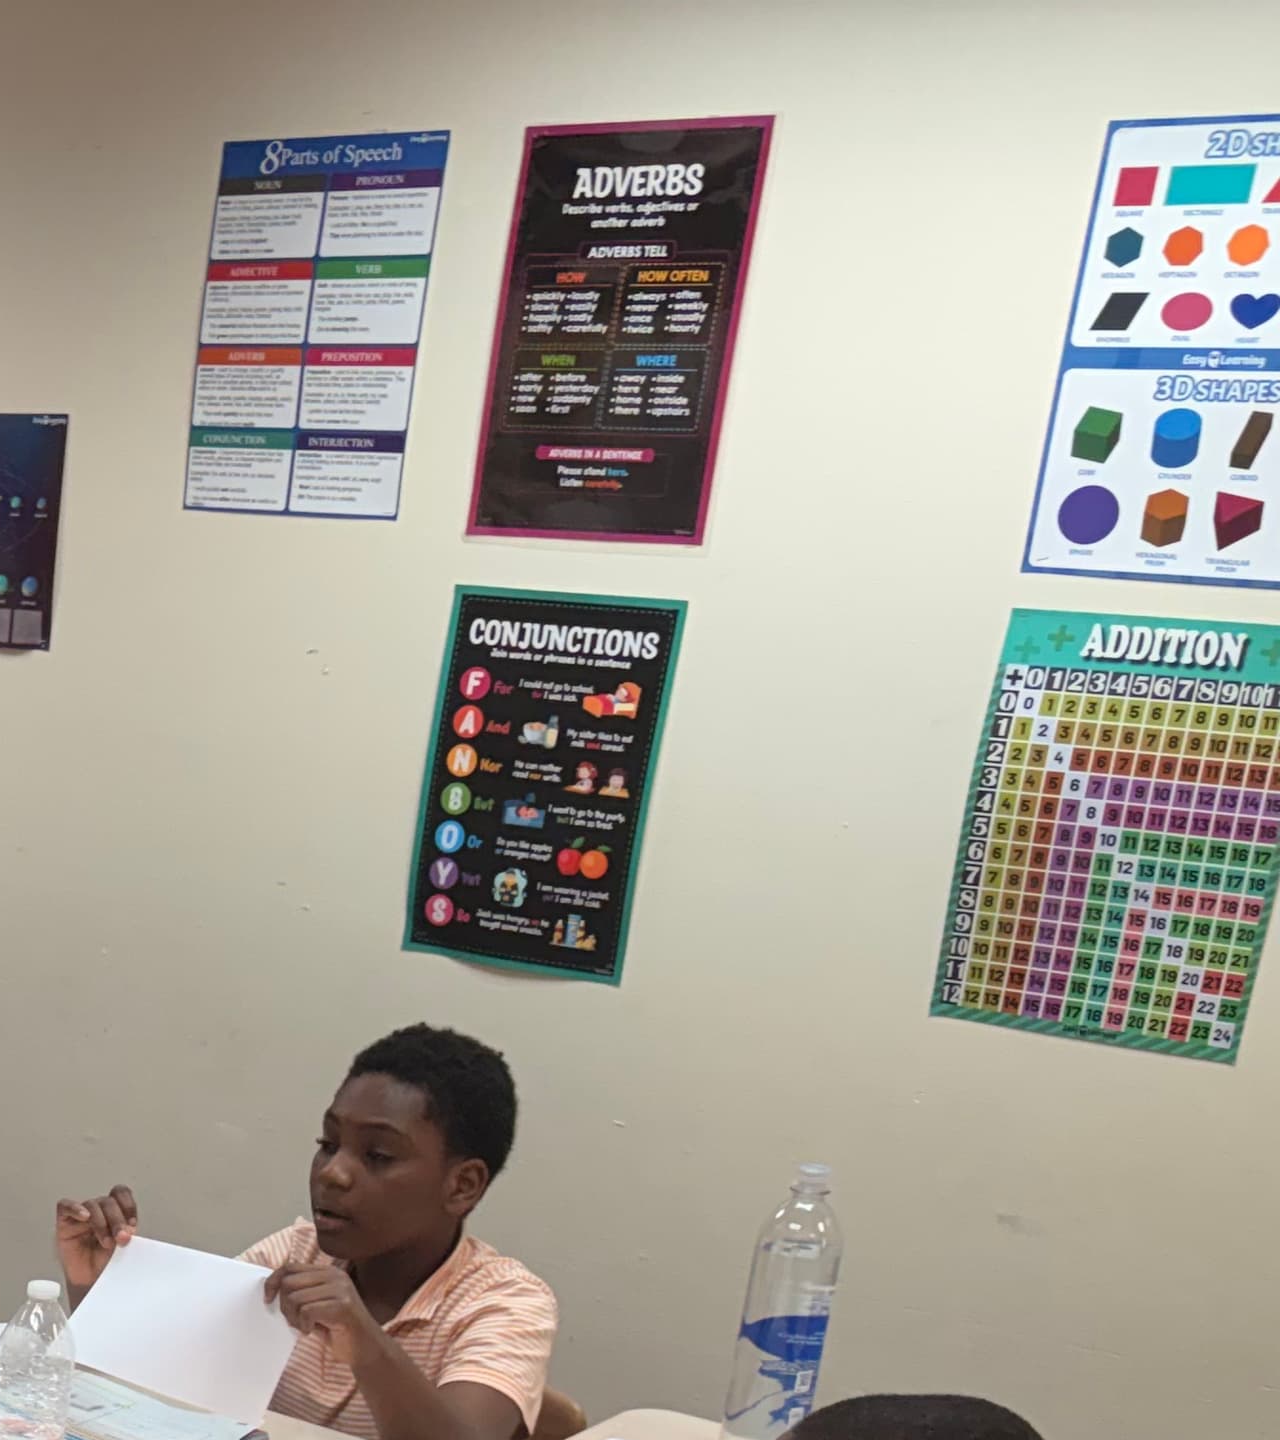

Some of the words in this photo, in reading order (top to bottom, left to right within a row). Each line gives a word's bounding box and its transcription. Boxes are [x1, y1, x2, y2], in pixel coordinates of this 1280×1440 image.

[1204, 129, 1250, 159] 2D
[259, 139, 283, 175] 8
[281, 145, 319, 167] Parts
[323, 142, 340, 163] of
[343, 144, 403, 170] Speech
[254, 178, 282, 191] NOUN
[355, 173, 405, 186] PRONOUN
[573, 163, 705, 199] ADVERBS
[588, 245, 640, 259] ADVERBS
[643, 244, 668, 258] TELL
[229, 265, 279, 278] ADJECTIVE
[355, 263, 382, 275] VERB
[555, 270, 586, 283] HOW
[638, 270, 666, 282] HOW
[669, 269, 709, 282] OFTEN
[228, 351, 266, 362] ADVERB
[321, 350, 384, 363] PREPOSITION
[542, 354, 576, 367] WHEN
[636, 354, 678, 367] WHERE
[1182, 354, 1207, 368] Easy
[1220, 354, 1267, 369] Learning
[1153, 375, 1195, 401] 3D
[202, 433, 267, 446] CONJUNCTION
[308, 436, 375, 448] INTERJECTION
[469, 617, 660, 660] CONJUNCTIONS
[1080, 623, 1248, 668] ADDITION
[465, 671, 483, 695] F
[493, 682, 514, 695] For
[1028, 668, 1042, 687] 0
[1050, 670, 1062, 689] 1
[1068, 671, 1086, 690] 2
[1089, 673, 1107, 692] 3
[1110, 675, 1127, 694] 4
[1132, 676, 1148, 695] 5
[1153, 678, 1171, 697] 6
[1177, 680, 1195, 699] 7
[1198, 682, 1215, 701] 8
[1220, 684, 1238, 703] 9
[1240, 685, 1263, 706] 10
[459, 710, 476, 734] A
[452, 749, 471, 770] N
[448, 786, 464, 810] B
[443, 826, 456, 847] O
[437, 860, 453, 884] Y
[432, 898, 446, 921] S
